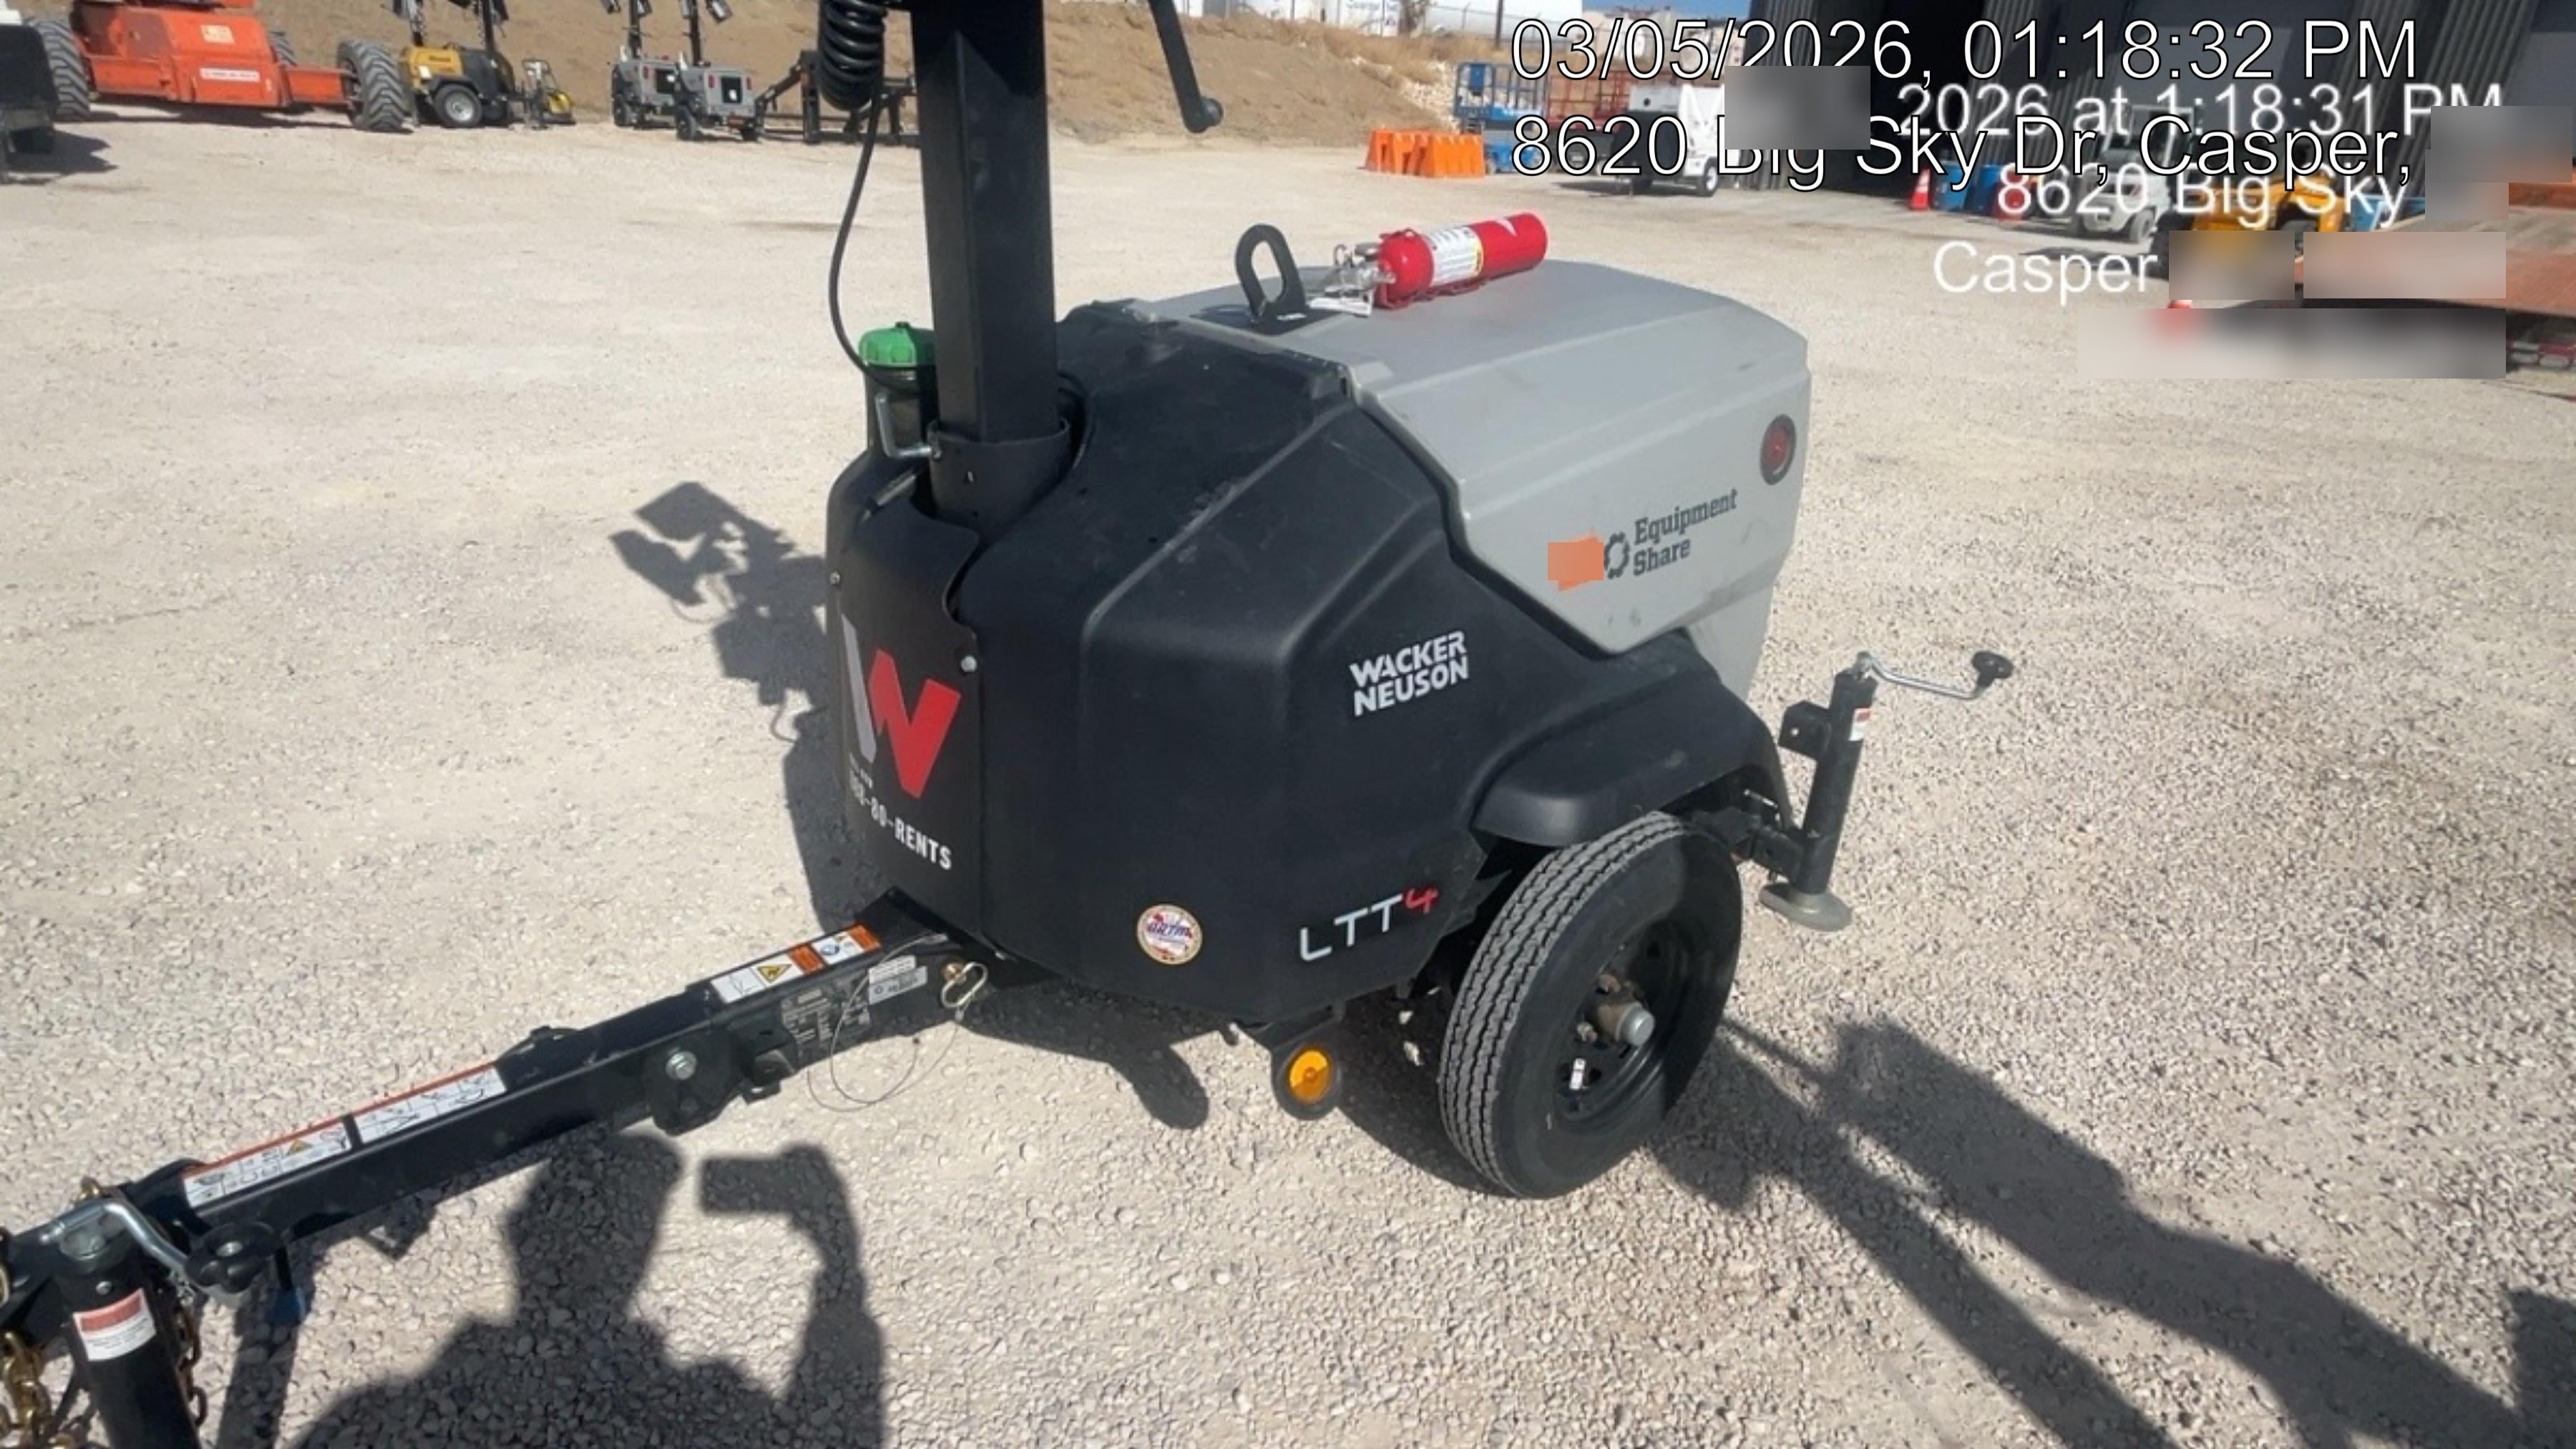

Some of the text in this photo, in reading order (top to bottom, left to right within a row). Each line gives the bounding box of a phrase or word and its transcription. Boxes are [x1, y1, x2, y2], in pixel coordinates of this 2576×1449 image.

[1633, 487, 1738, 545] Equipment
[1633, 538, 1692, 576] Share
[1349, 630, 1468, 688] WACKER
[1353, 655, 1469, 717] NEUSON
[1299, 888, 1439, 962] LTT4
